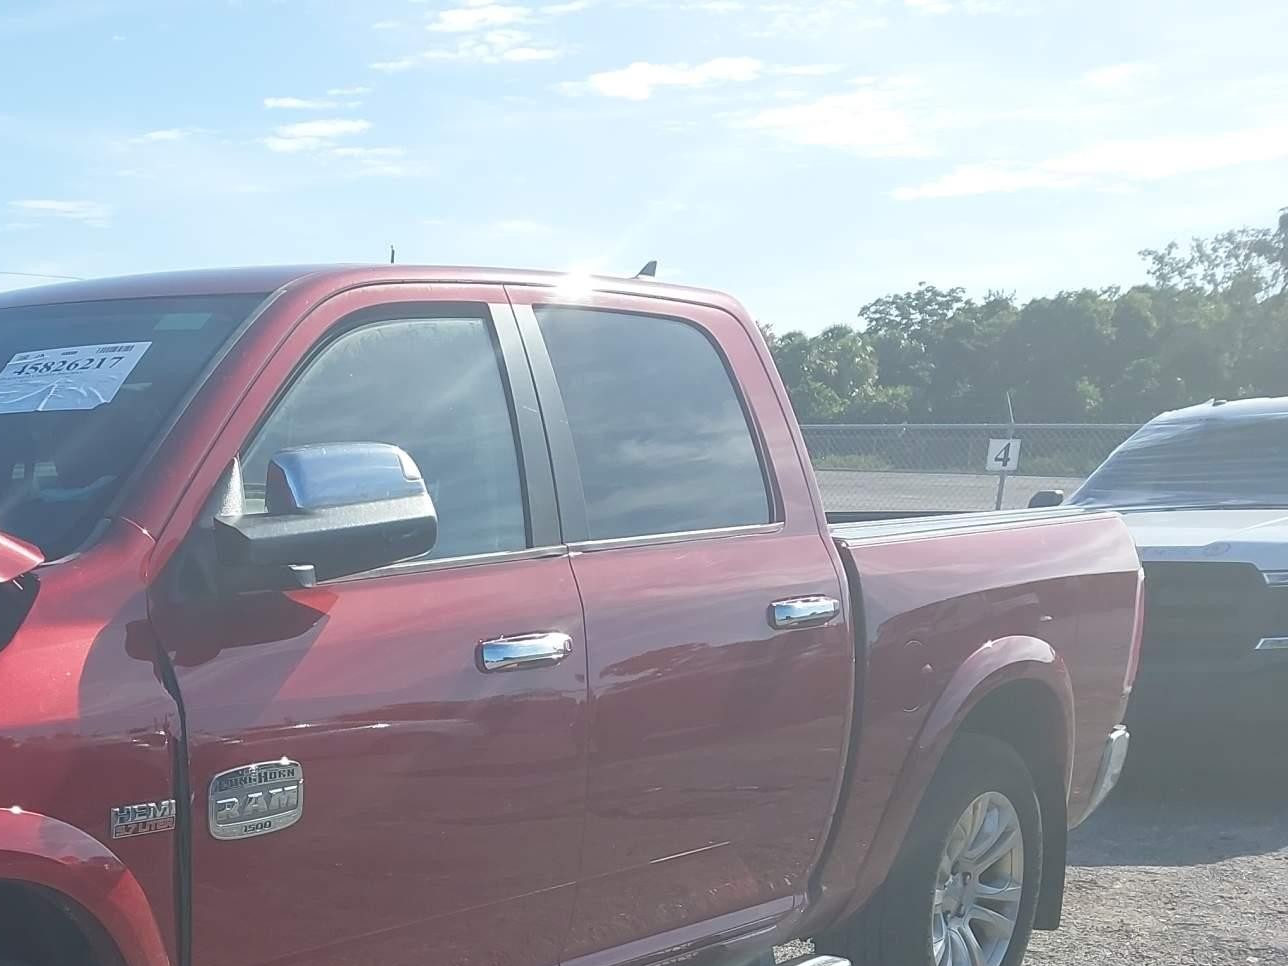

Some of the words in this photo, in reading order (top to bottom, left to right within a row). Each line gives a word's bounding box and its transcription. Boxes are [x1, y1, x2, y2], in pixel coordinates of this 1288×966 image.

[13, 356, 125, 376] 45826217
[994, 442, 1010, 467] 4
[112, 800, 176, 824] HEMI
[216, 785, 298, 822] RAM
[138, 817, 174, 833] LITER
[243, 820, 272, 833] 1500
